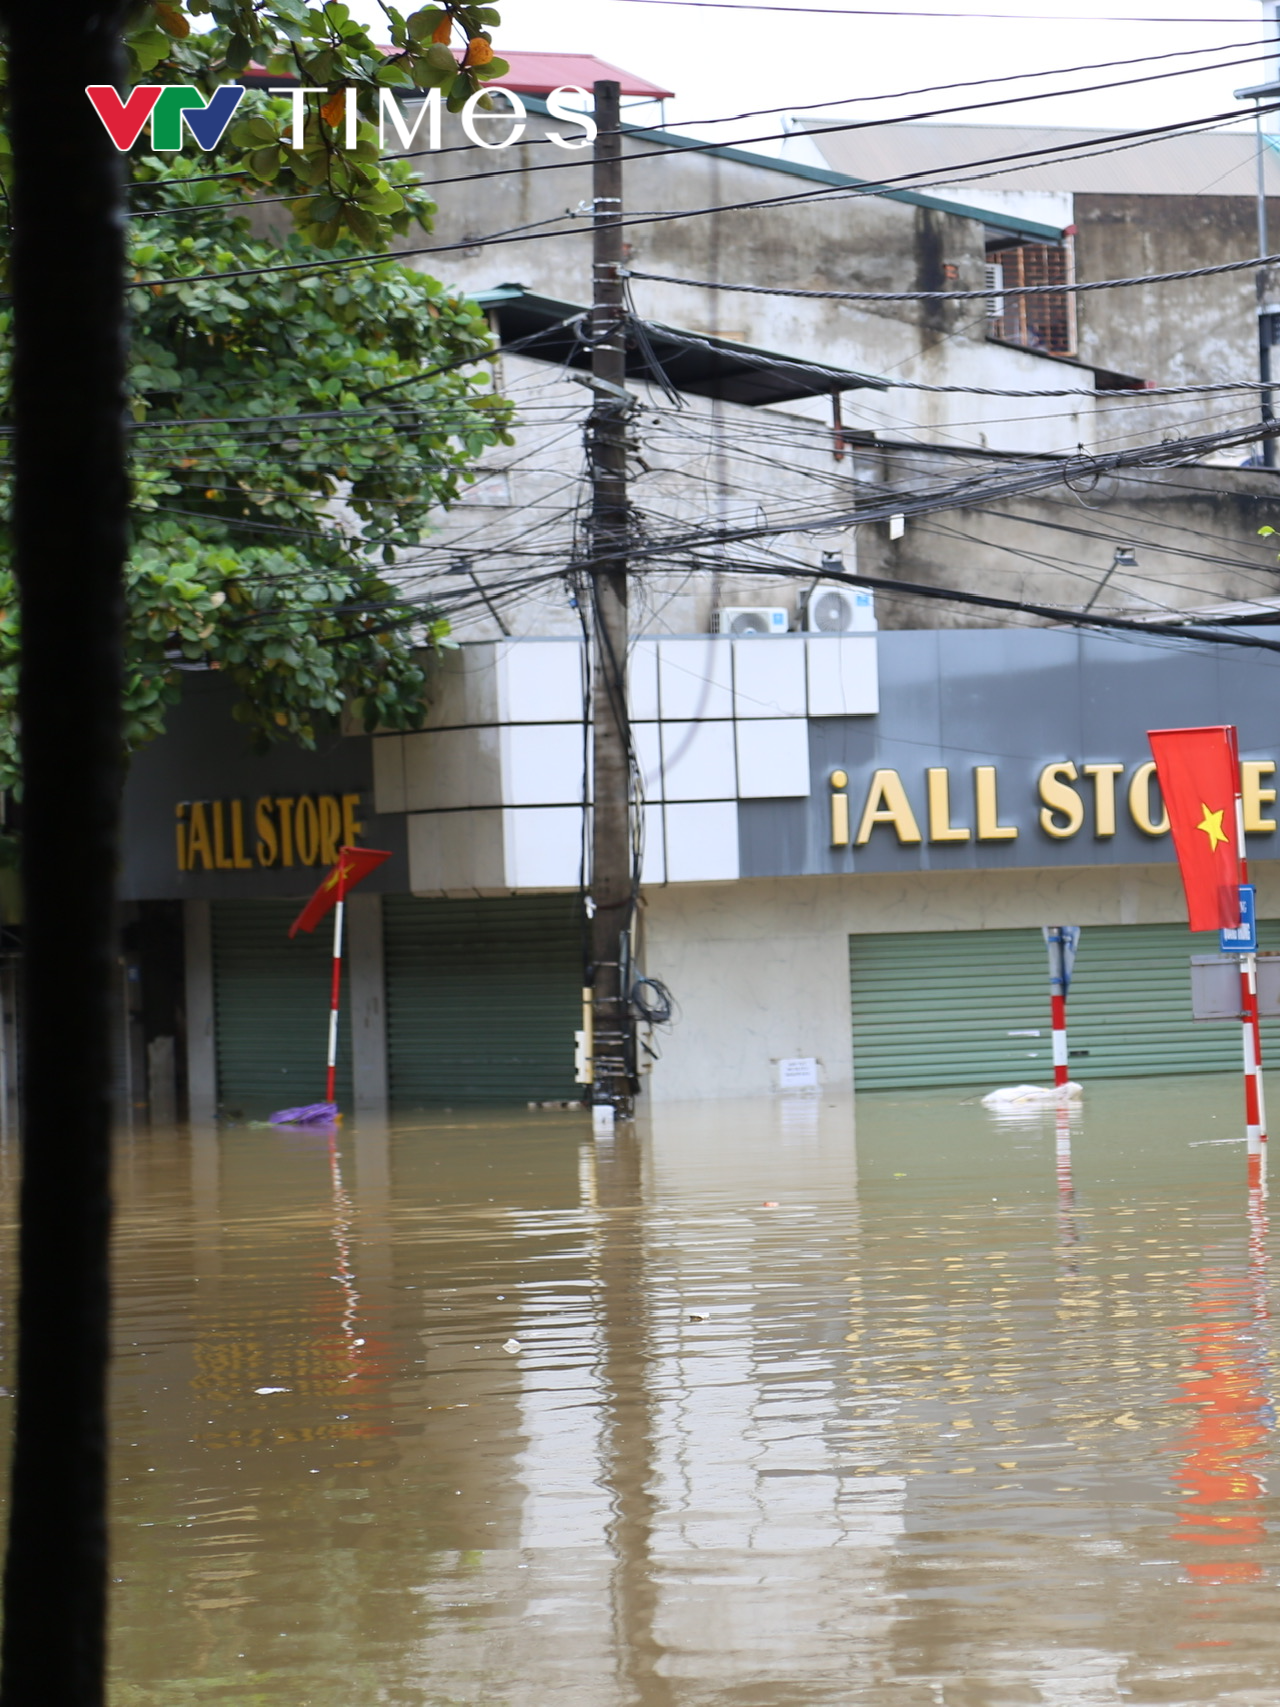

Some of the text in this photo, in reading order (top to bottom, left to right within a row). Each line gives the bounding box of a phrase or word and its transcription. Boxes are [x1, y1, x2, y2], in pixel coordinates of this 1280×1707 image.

[176, 798, 253, 871] iALL
[830, 760, 1277, 847] iALL STOE
